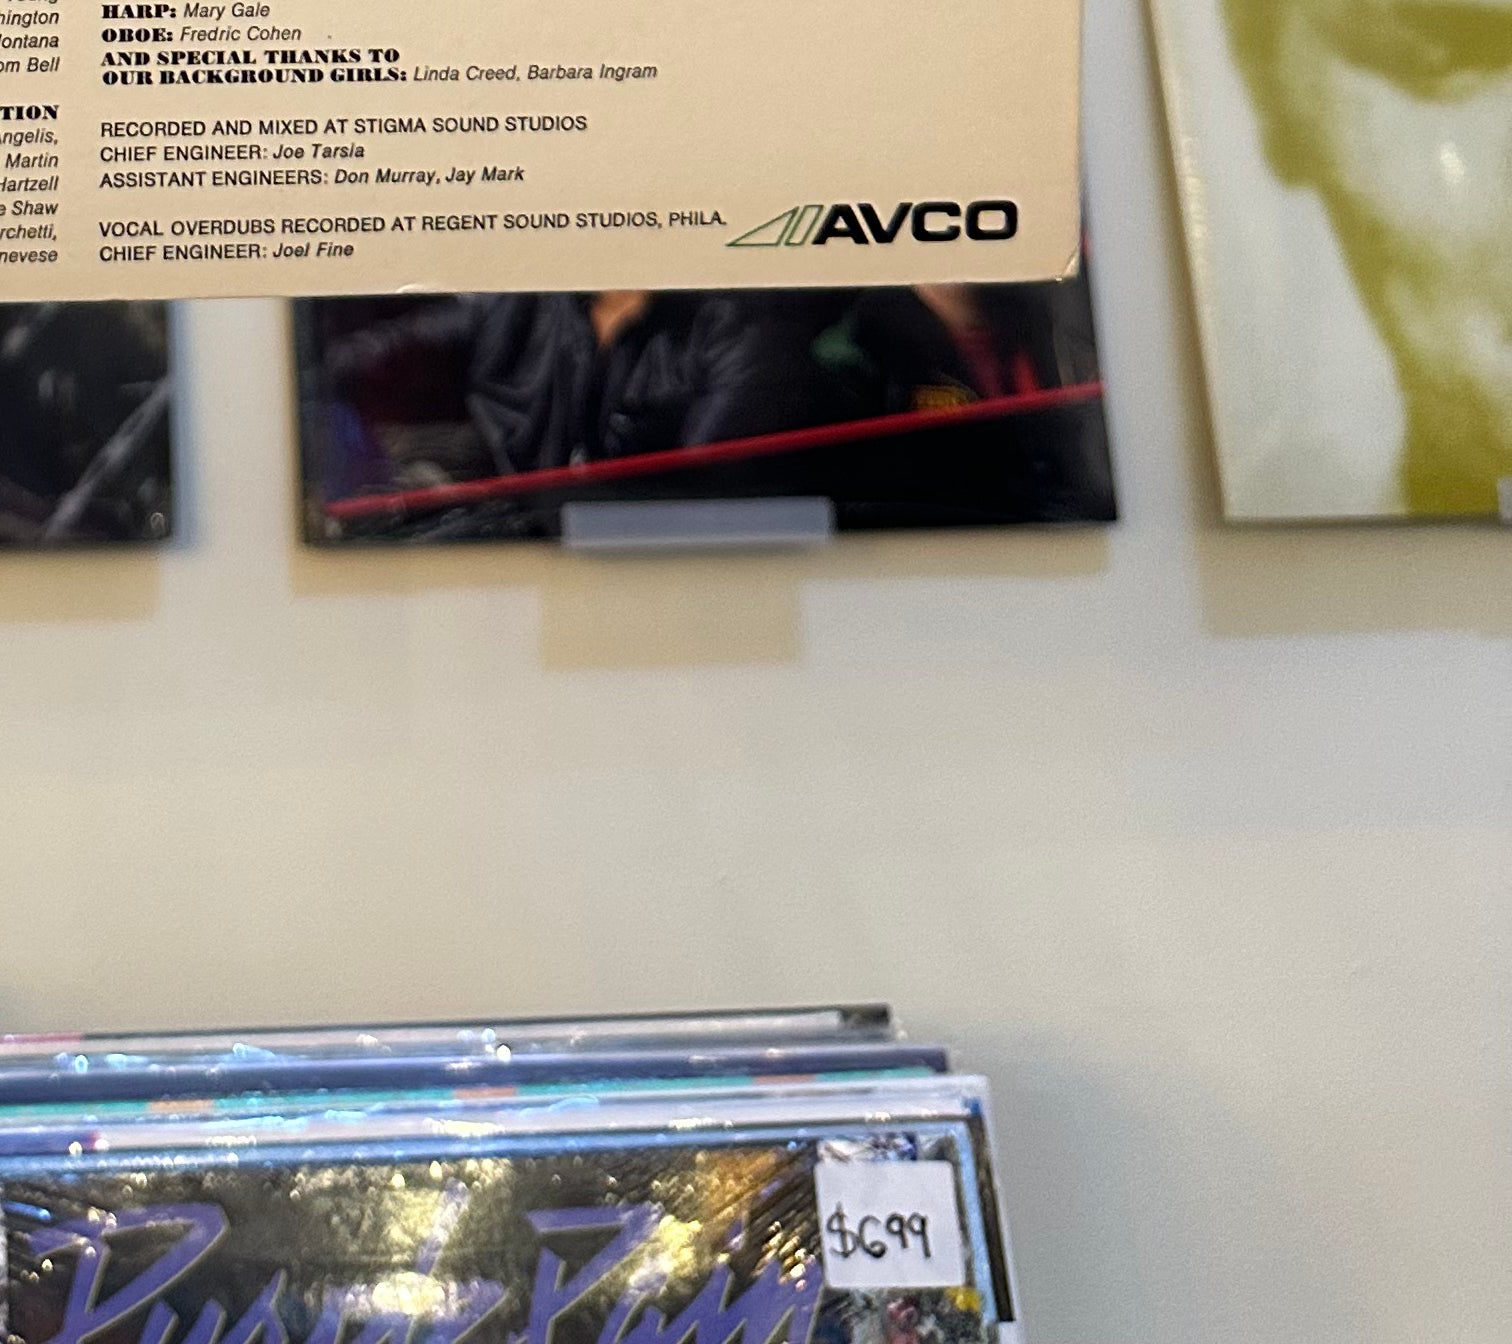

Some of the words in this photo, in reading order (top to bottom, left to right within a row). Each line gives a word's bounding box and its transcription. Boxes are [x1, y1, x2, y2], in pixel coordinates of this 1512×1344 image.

[101, 4, 176, 19] HARP:
[184, 2, 226, 21] Mary
[232, 2, 270, 18] Gale
[101, 28, 173, 43] OBOE:
[180, 26, 240, 42] Fredric
[247, 26, 302, 41] Cohen
[100, 51, 150, 66] AND
[156, 50, 256, 66] SPECIAL
[263, 49, 361, 64] THANKS
[368, 48, 400, 63] TO
[101, 121, 206, 138] RECORDED
[212, 120, 252, 136] AND
[259, 119, 318, 136] MIXED
[323, 118, 349, 134] AT
[432, 116, 500, 133] SOUND
[505, 116, 588, 132] STUDIOS
[812, 200, 1018, 245] AVCO
[826, 1202, 932, 1260] $699
